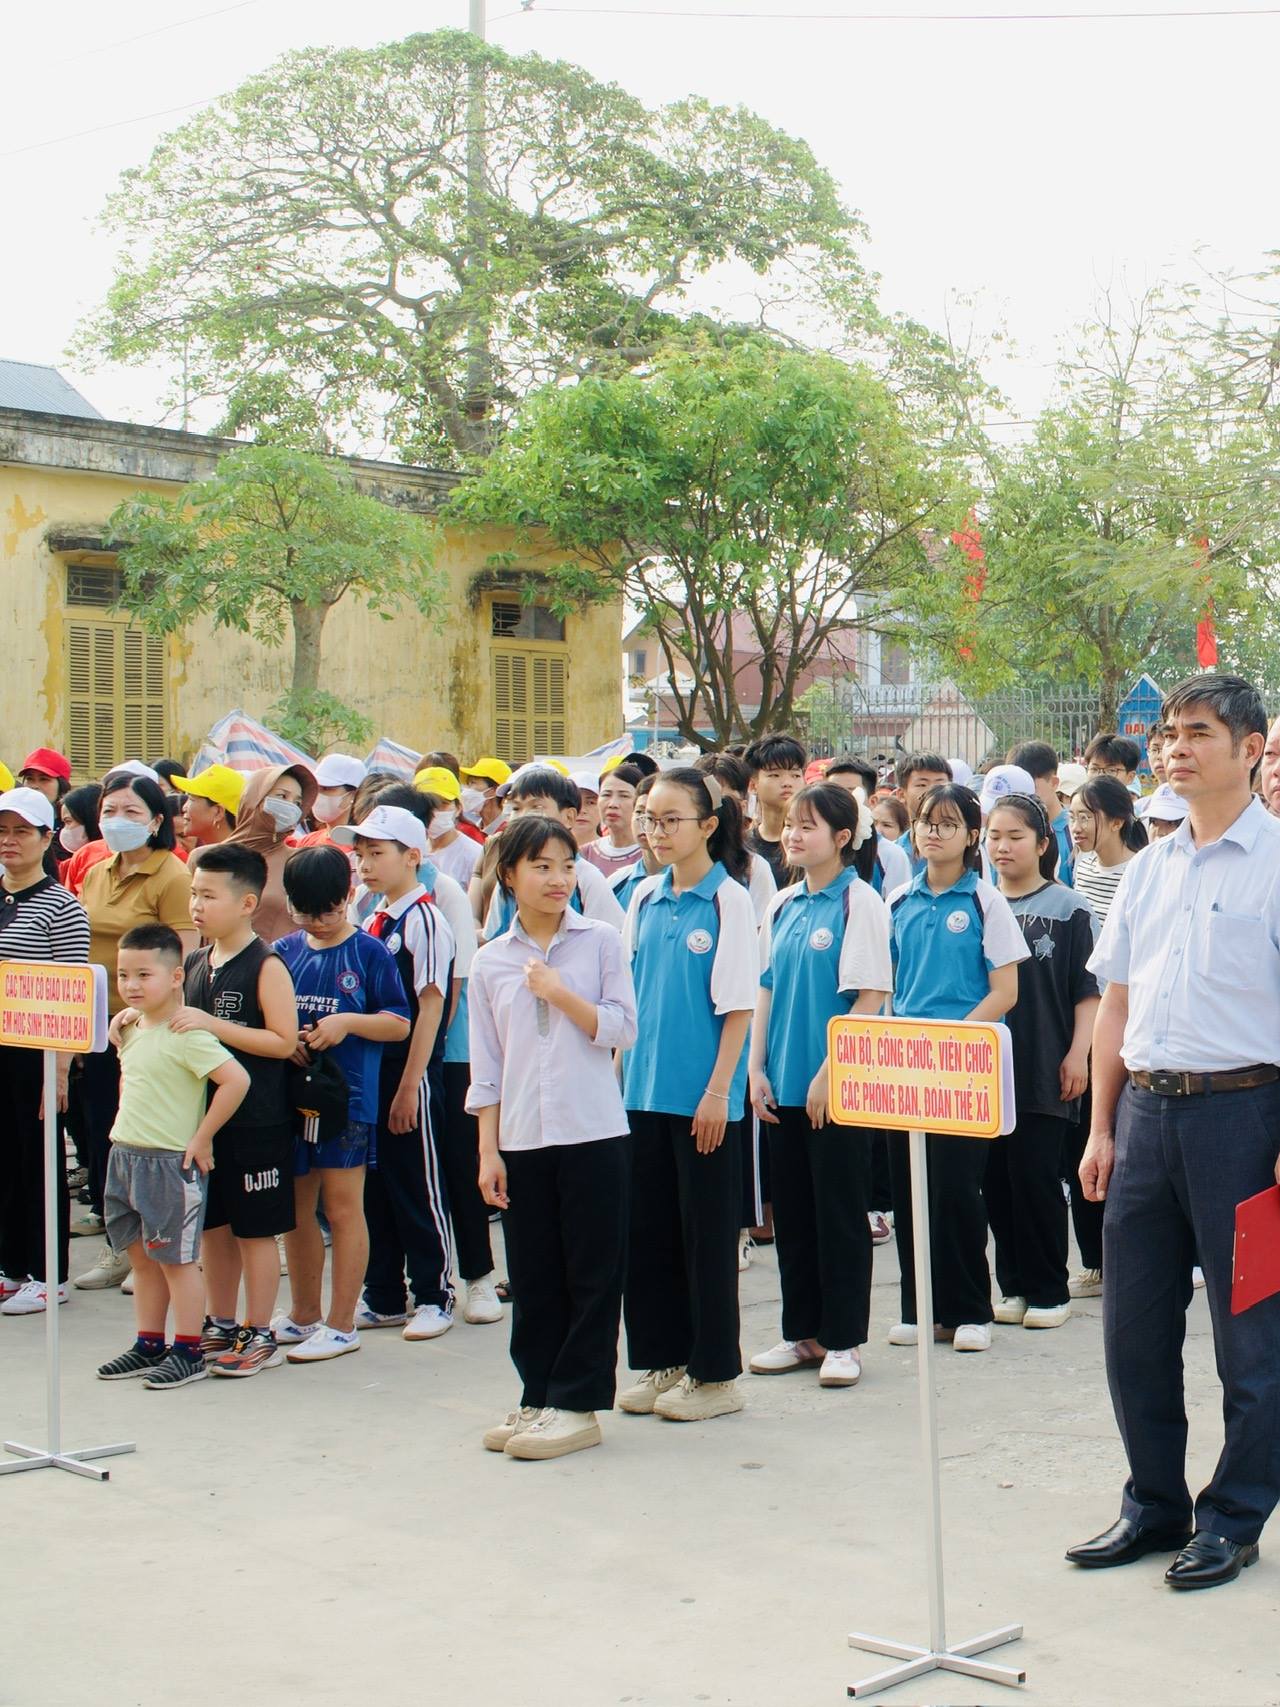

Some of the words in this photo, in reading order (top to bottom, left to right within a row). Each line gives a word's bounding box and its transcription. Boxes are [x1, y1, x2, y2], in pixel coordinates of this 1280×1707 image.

[6, 970, 18, 998] CÁC
[36, 972, 44, 1001] CÔ
[45, 973, 60, 1002] GIÁO
[73, 975, 86, 1003] CÁC
[296, 995, 340, 1006] INFINITE
[3, 1010, 12, 1033] EM
[14, 1011, 26, 1040] HỌC
[28, 1012, 42, 1037] SINH
[44, 1010, 60, 1039] TRÊN
[74, 1012, 89, 1041] BÀN
[837, 1028, 857, 1065] CÁN
[859, 1029, 875, 1072] BỘ,
[877, 1030, 904, 1068] CÔNG
[906, 1032, 937, 1073] CHỨC,
[939, 1035, 963, 1072] VIÊN
[965, 1037, 993, 1075] CHỨC
[841, 1075, 860, 1111] CÁC
[862, 1076, 895, 1114] PHÒNG
[898, 1085, 922, 1120] BAN,
[924, 1081, 951, 1119] ĐOÀN
[954, 1077, 973, 1121] THỂ
[976, 1085, 990, 1123] XÃ
